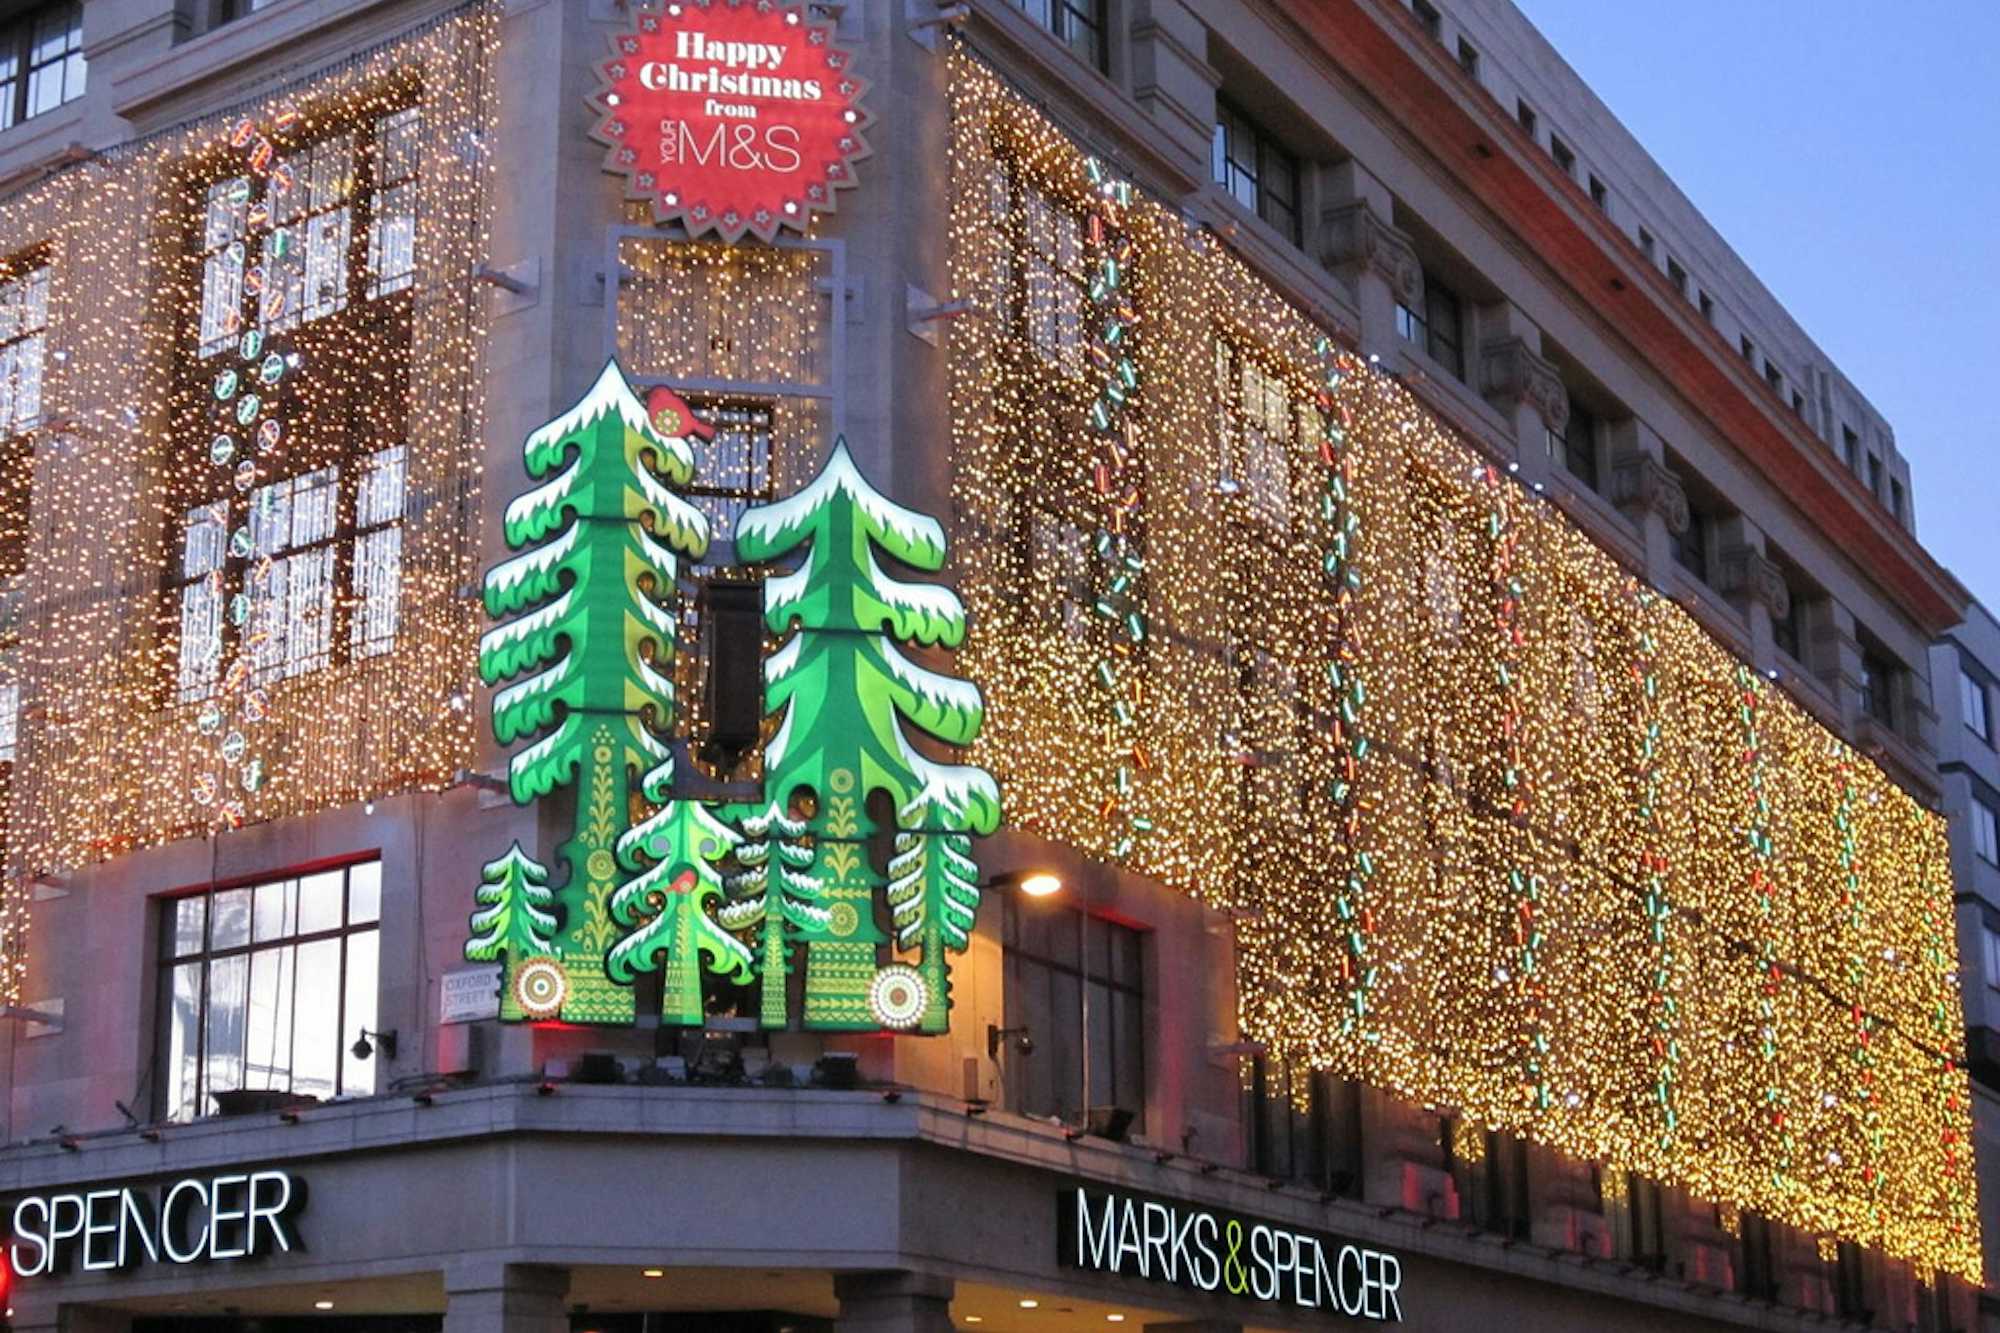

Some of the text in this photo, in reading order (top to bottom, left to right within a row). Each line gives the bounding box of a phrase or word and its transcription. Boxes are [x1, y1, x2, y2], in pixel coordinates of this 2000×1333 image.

[676, 32, 786, 69] Happy
[640, 62, 822, 100] Christmas
[705, 99, 757, 118] from
[660, 119, 676, 164] YOUR
[678, 120, 800, 173] M&S
[11, 1171, 291, 1277] SPENCER
